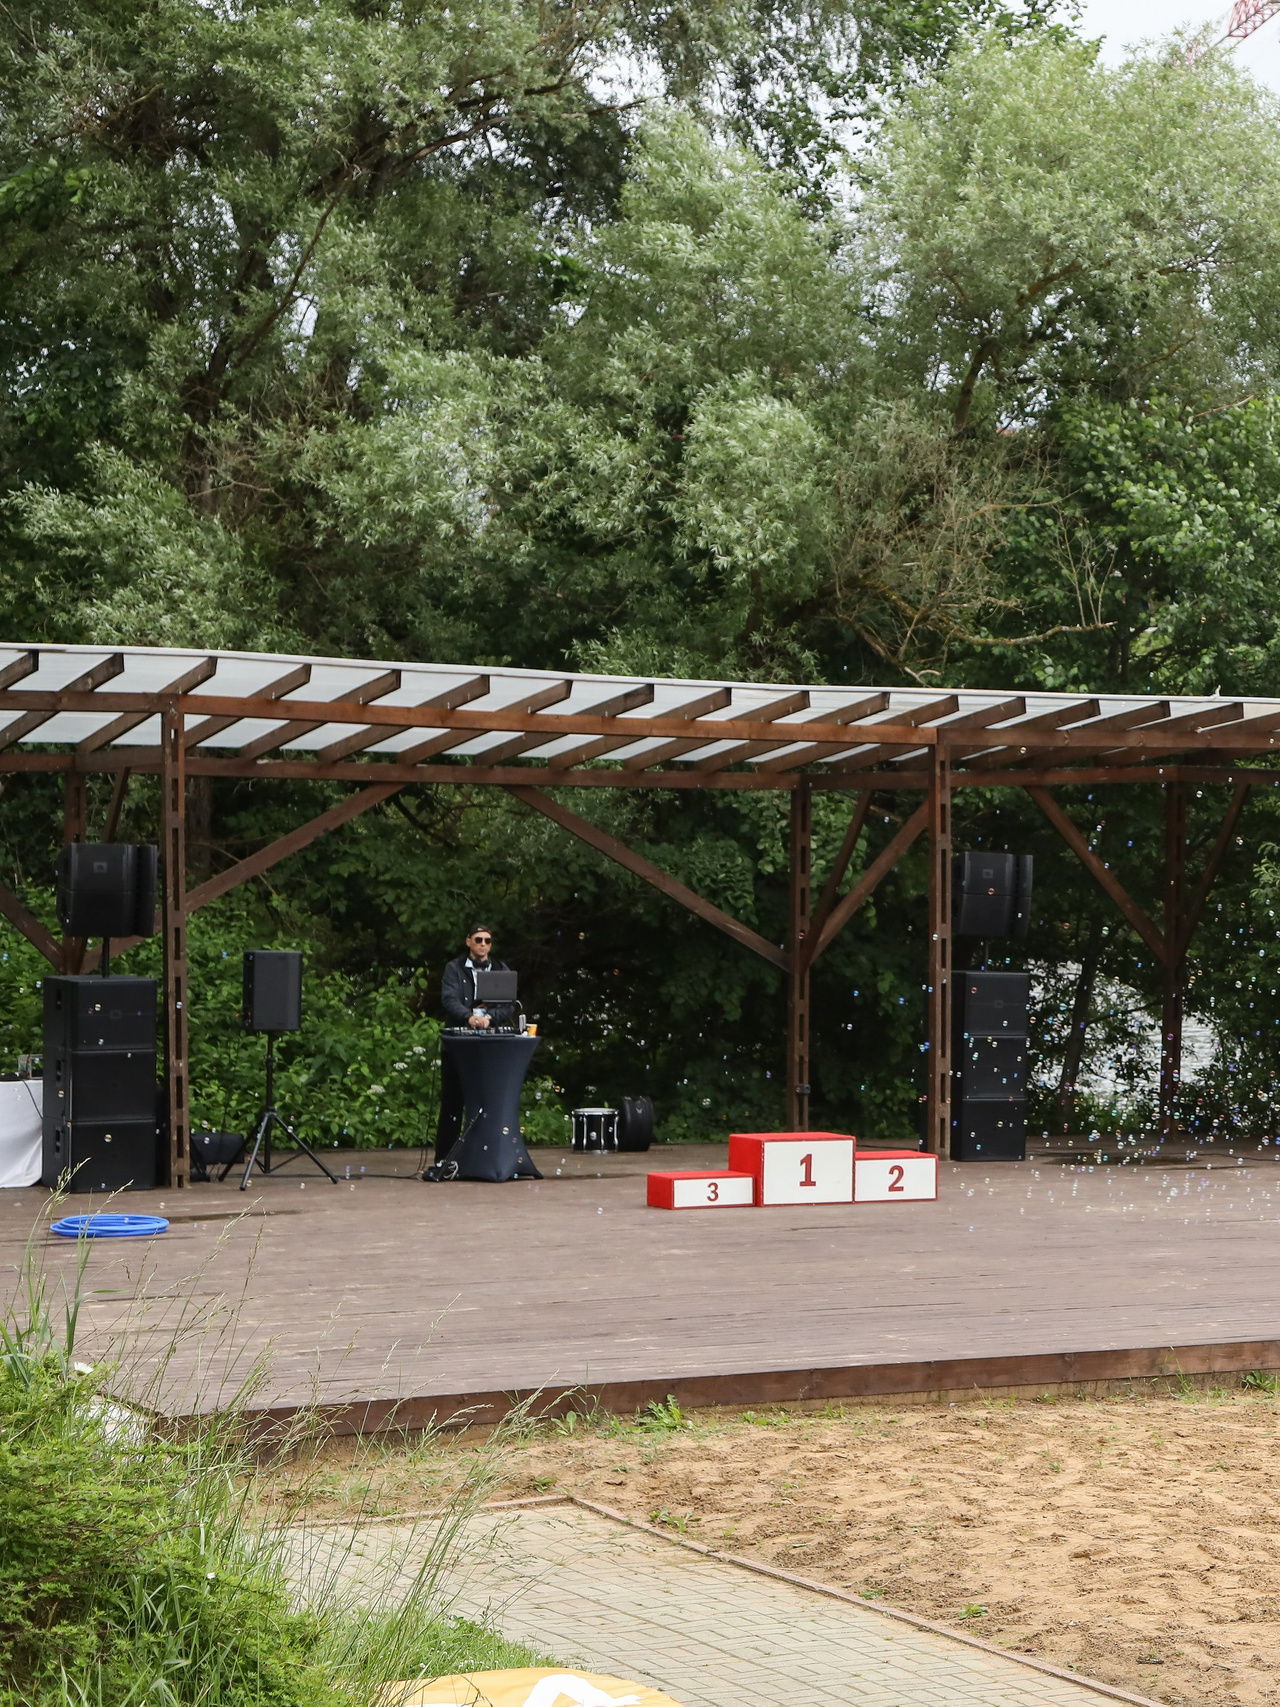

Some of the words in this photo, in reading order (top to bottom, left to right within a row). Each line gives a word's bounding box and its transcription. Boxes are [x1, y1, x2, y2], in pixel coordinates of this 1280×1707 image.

[799, 1153, 816, 1187] 1
[888, 1165, 904, 1192] 2
[706, 1182, 719, 1202] 3
